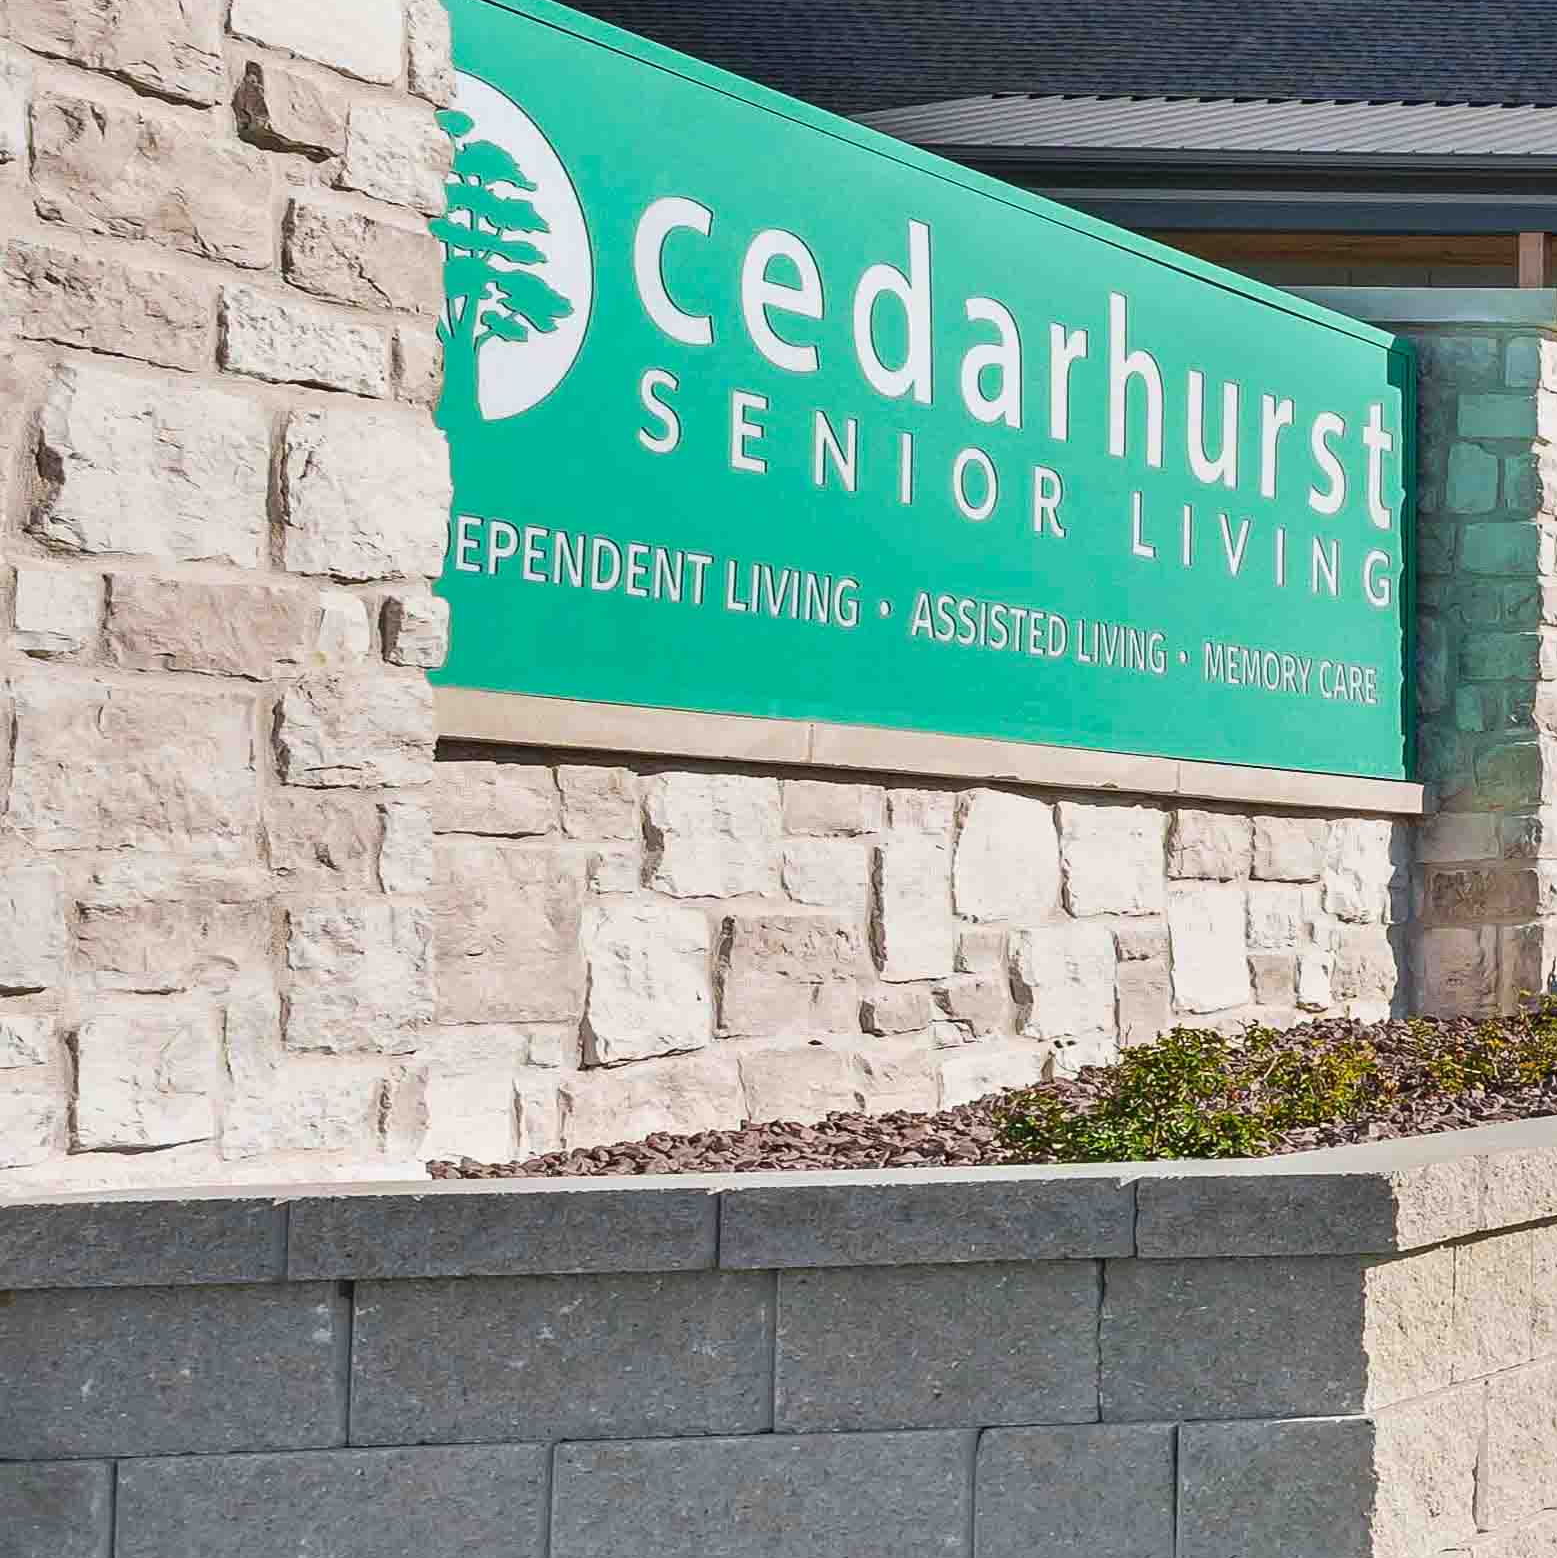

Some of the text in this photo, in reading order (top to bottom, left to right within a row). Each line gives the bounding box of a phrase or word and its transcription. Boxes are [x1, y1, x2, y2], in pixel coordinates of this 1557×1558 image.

[633, 196, 1393, 532] cedarhurst
[445, 514, 1378, 705] EPENDENT LIVING ASSISTED LIVING MEMORY CARE
[637, 368, 1393, 610] SENIOR LIVING
